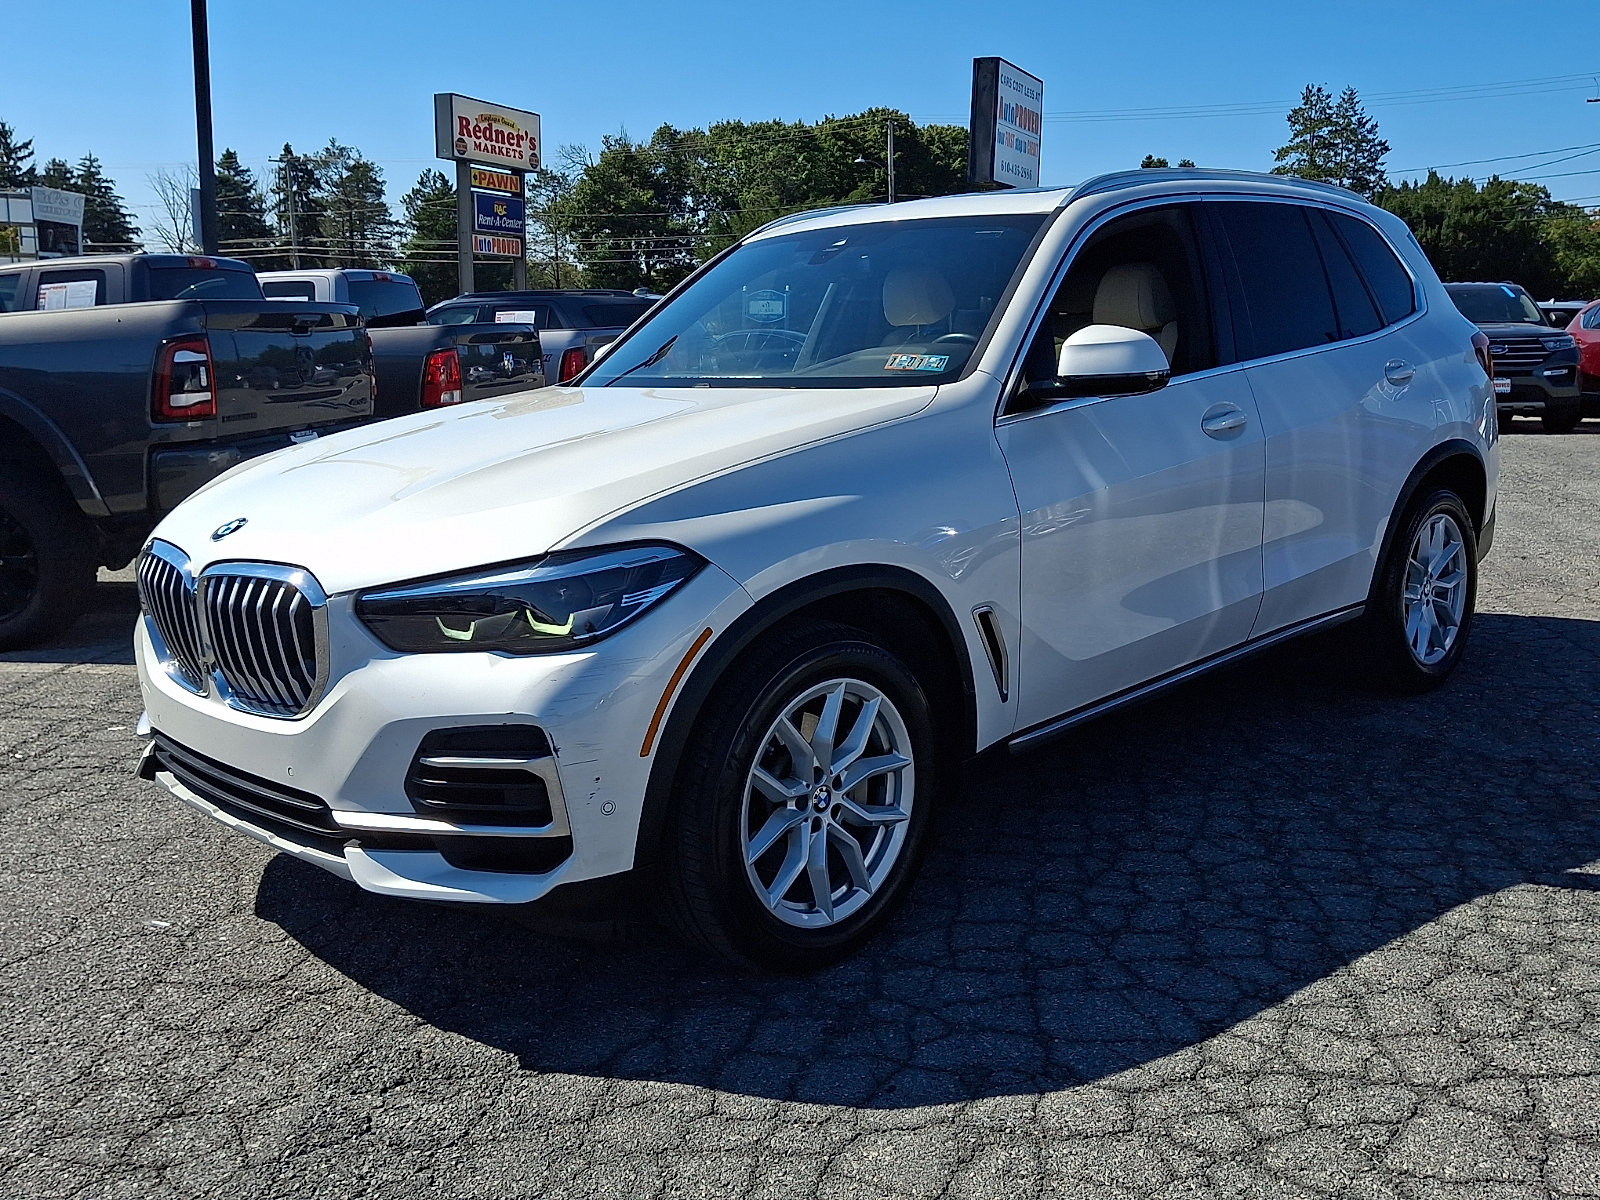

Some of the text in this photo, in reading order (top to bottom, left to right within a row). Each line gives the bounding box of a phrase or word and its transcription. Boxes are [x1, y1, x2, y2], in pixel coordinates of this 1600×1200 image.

[1000, 73, 1013, 89] CARS
[1012, 79, 1024, 94] COST
[1024, 85, 1035, 100] LESS
[998, 95, 1039, 135] AutoPROVED
[457, 115, 537, 151] Redner's
[473, 140, 524, 161] MARKETS
[478, 170, 519, 191] PAWN
[473, 235, 521, 256] AutoPROVED
